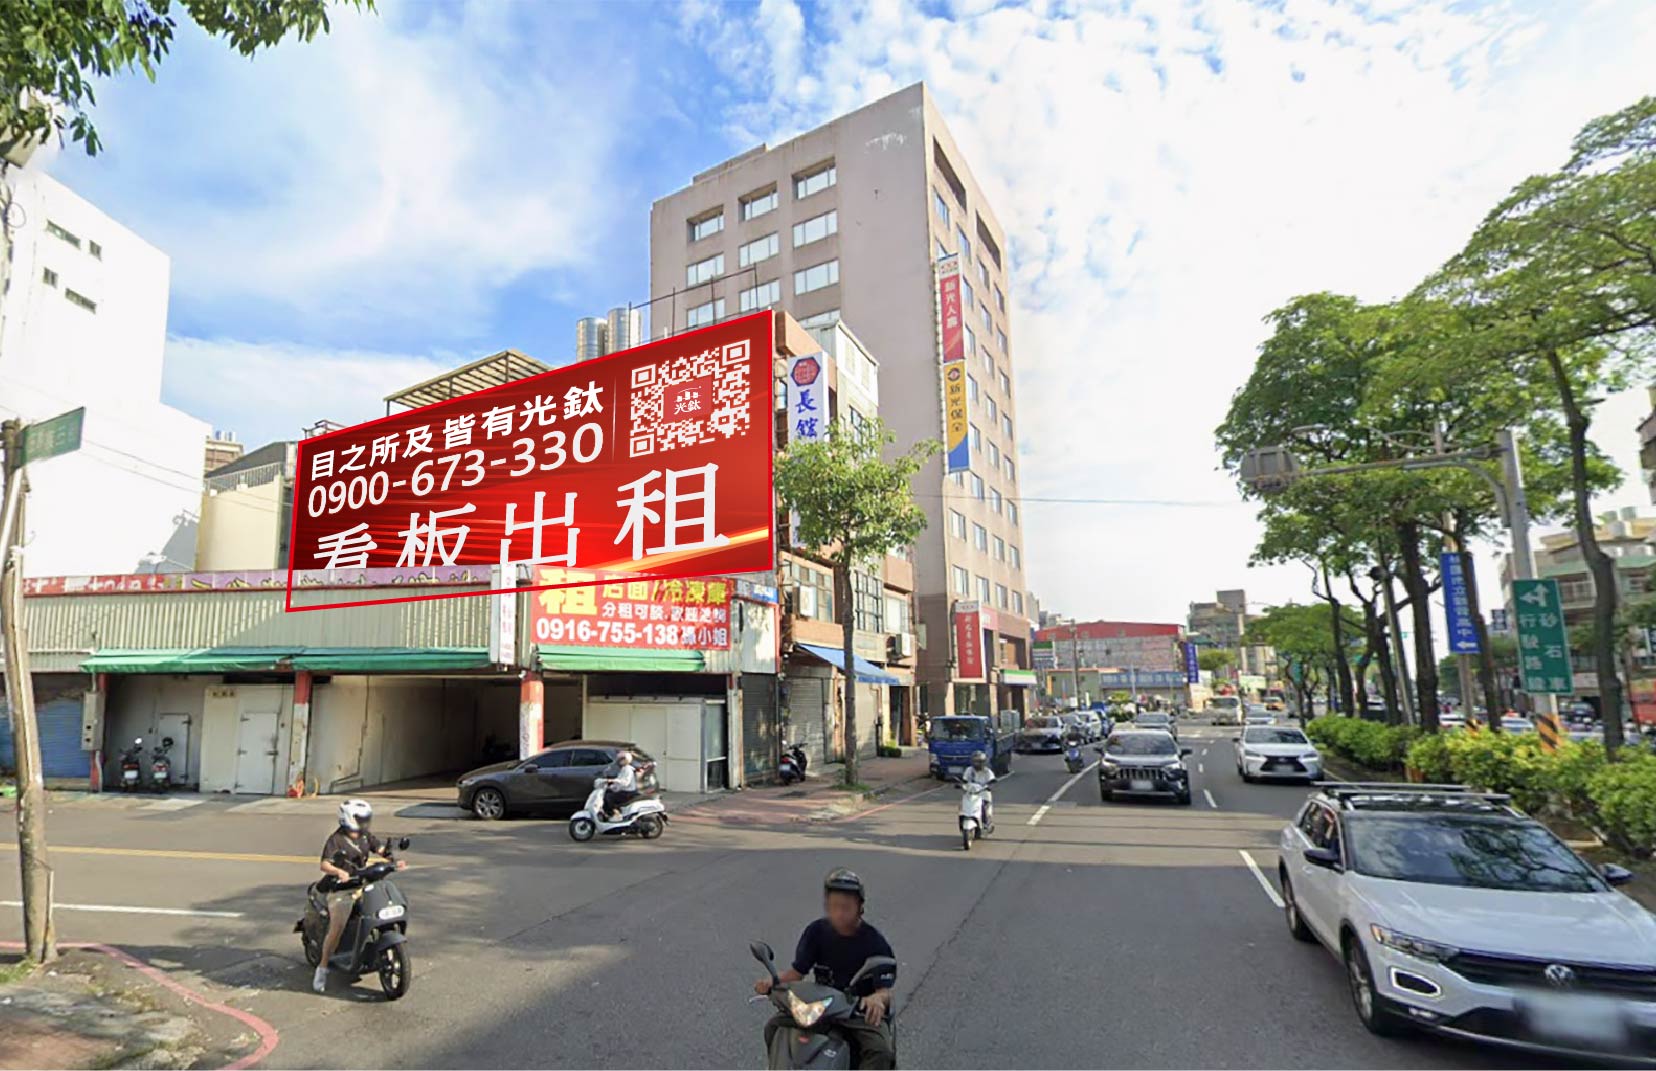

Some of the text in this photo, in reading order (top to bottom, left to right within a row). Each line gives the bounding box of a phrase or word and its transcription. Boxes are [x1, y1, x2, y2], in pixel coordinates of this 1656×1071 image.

[308, 423, 604, 518] 0900-673-330
[313, 462, 730, 570] 看板出租
[538, 568, 597, 616] 租
[536, 617, 679, 645] 0916-755-138
